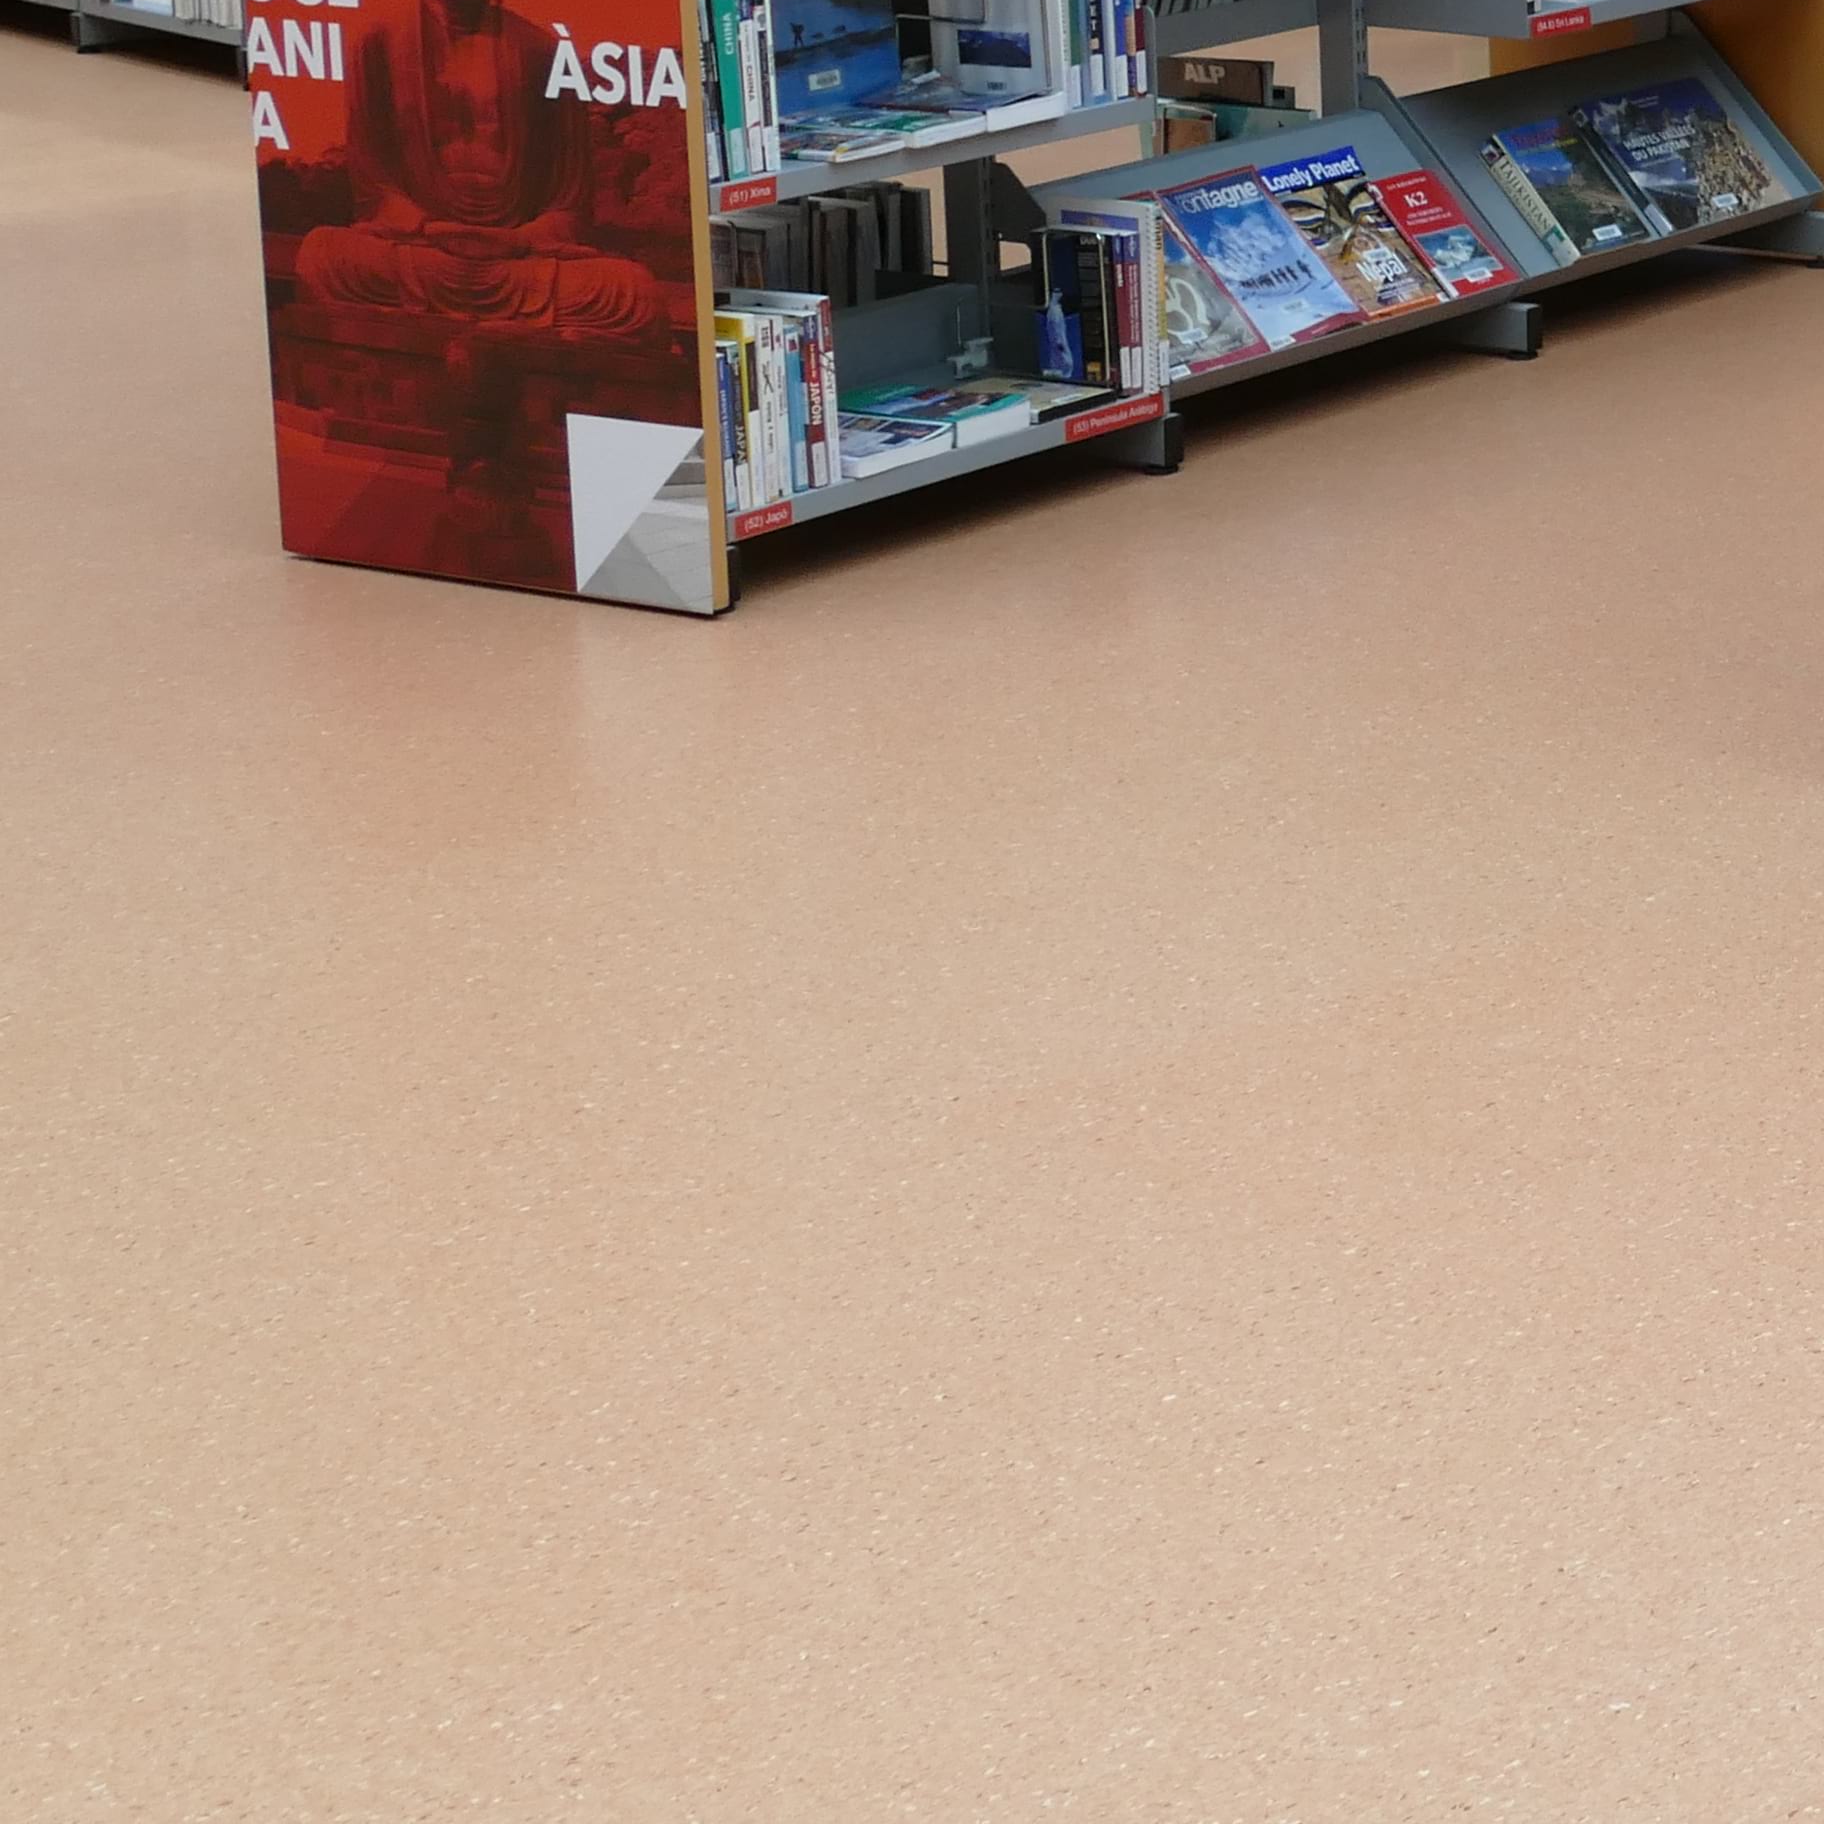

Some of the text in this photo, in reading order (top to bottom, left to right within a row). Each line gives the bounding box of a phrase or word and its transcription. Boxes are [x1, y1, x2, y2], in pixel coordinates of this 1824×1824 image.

[246, 15, 344, 81] ANI
[721, 12, 734, 56] CHINA
[543, 22, 687, 111] ÀSIA
[1182, 62, 1226, 85] ALP
[254, 90, 291, 152] A
[1263, 153, 1360, 192] Lonely Planet
[728, 187, 747, 206] (51)
[1405, 191, 1429, 209] K2
[1357, 254, 1407, 284] Nepal
[743, 518, 765, 535] (52)
